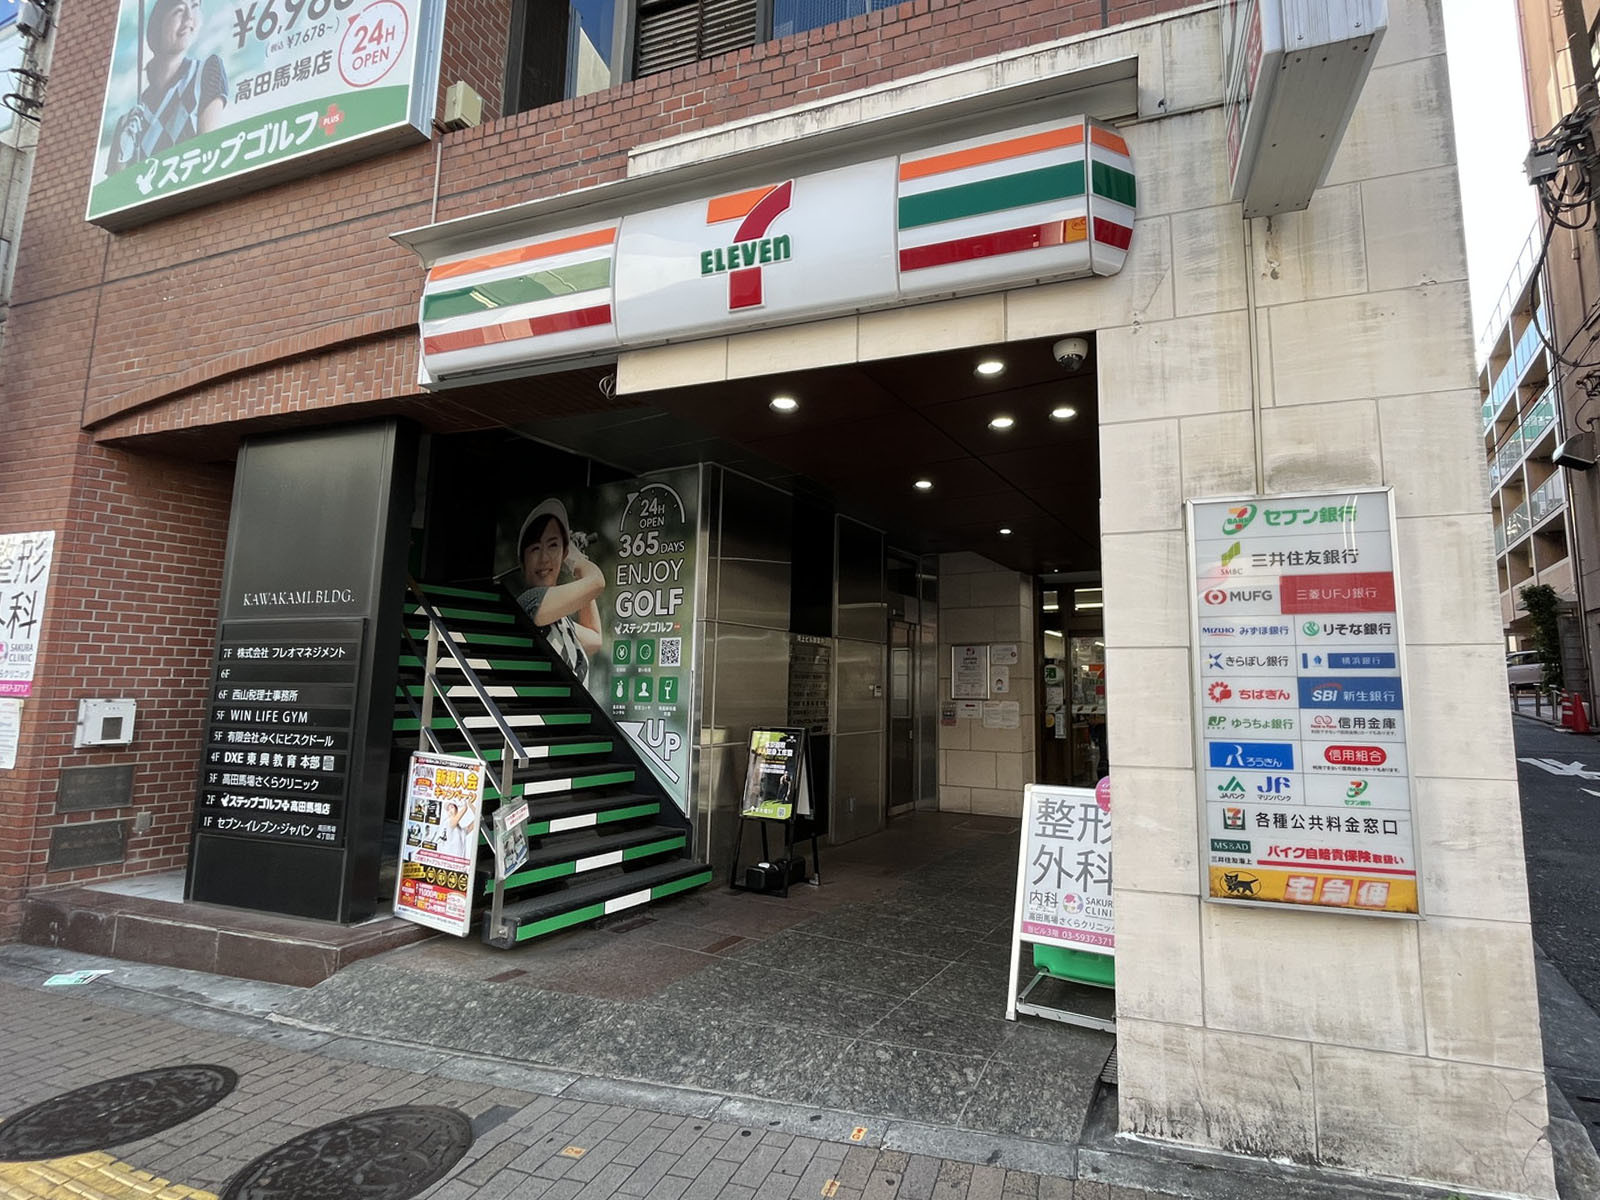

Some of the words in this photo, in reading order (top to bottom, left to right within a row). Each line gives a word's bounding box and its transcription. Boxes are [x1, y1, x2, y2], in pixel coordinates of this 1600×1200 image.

[352, 19, 395, 55] 24H
[352, 46, 390, 71] OPEN
[234, 49, 333, 104] 高田馬場店
[322, 114, 341, 126] PLUS
[158, 110, 320, 188] ステップゴルフ
[640, 497, 665, 517] 24H
[639, 516, 665, 529] OPEN
[1263, 505, 1357, 526] セブン銀行
[618, 530, 659, 558] 365
[660, 540, 685, 554] DAYS
[1251, 548, 1360, 568] 三井住友銀行
[616, 558, 684, 585] ENJOY
[1229, 589, 1273, 602] MUFG
[1296, 586, 1378, 601] 三菱UFJ銀行
[615, 588, 683, 618] GOLF
[622, 621, 674, 634] ステップゴルフ
[1239, 625, 1289, 635] みずほ銀行
[1323, 622, 1392, 636] りそな銀行
[10, 643, 34, 652] SAKURA
[223, 648, 233, 658] 7F
[237, 647, 269, 659] 株式会社
[272, 646, 346, 659] フレオマネジメント
[8, 653, 33, 663] CLINIC
[1225, 655, 1289, 668] きらぼし銀行
[1341, 655, 1382, 666] 横浜銀行
[220, 668, 231, 679] 6F
[218, 689, 228, 700] 6F
[1238, 688, 1291, 701] ちばぎん
[1312, 688, 1338, 702] SBI
[1343, 690, 1396, 702] 新生銀行
[216, 710, 225, 721] 5F
[230, 709, 252, 721] WIN
[255, 710, 279, 723] LIFE
[282, 711, 308, 724] GYM
[1231, 717, 1294, 730] ゆうちょ銀行
[1338, 716, 1397, 730] 信用金庫
[213, 732, 223, 742] 5F
[227, 731, 334, 747] 有限会社みくにビスクドール
[646, 718, 682, 762] UP
[210, 752, 220, 762] 4F
[1247, 756, 1283, 768] ろうきん
[1328, 749, 1382, 762] 信用組合
[208, 773, 218, 784] 3F
[222, 773, 319, 791] 高田馬場さくらクリニック
[206, 794, 216, 805] 2F
[1219, 792, 1246, 800] JAバンク
[1256, 794, 1292, 802] マリンバンク
[203, 816, 213, 827] 1F
[1034, 797, 1112, 845] 整形
[1255, 812, 1398, 835] 各種公共料金窓口
[1213, 842, 1249, 852] MS&AD
[1267, 845, 1404, 865] バイク自賠責保険取扱い
[1032, 844, 1113, 896] 外科
[1029, 889, 1059, 908] 内科
[1286, 876, 1389, 908] 宅急便
